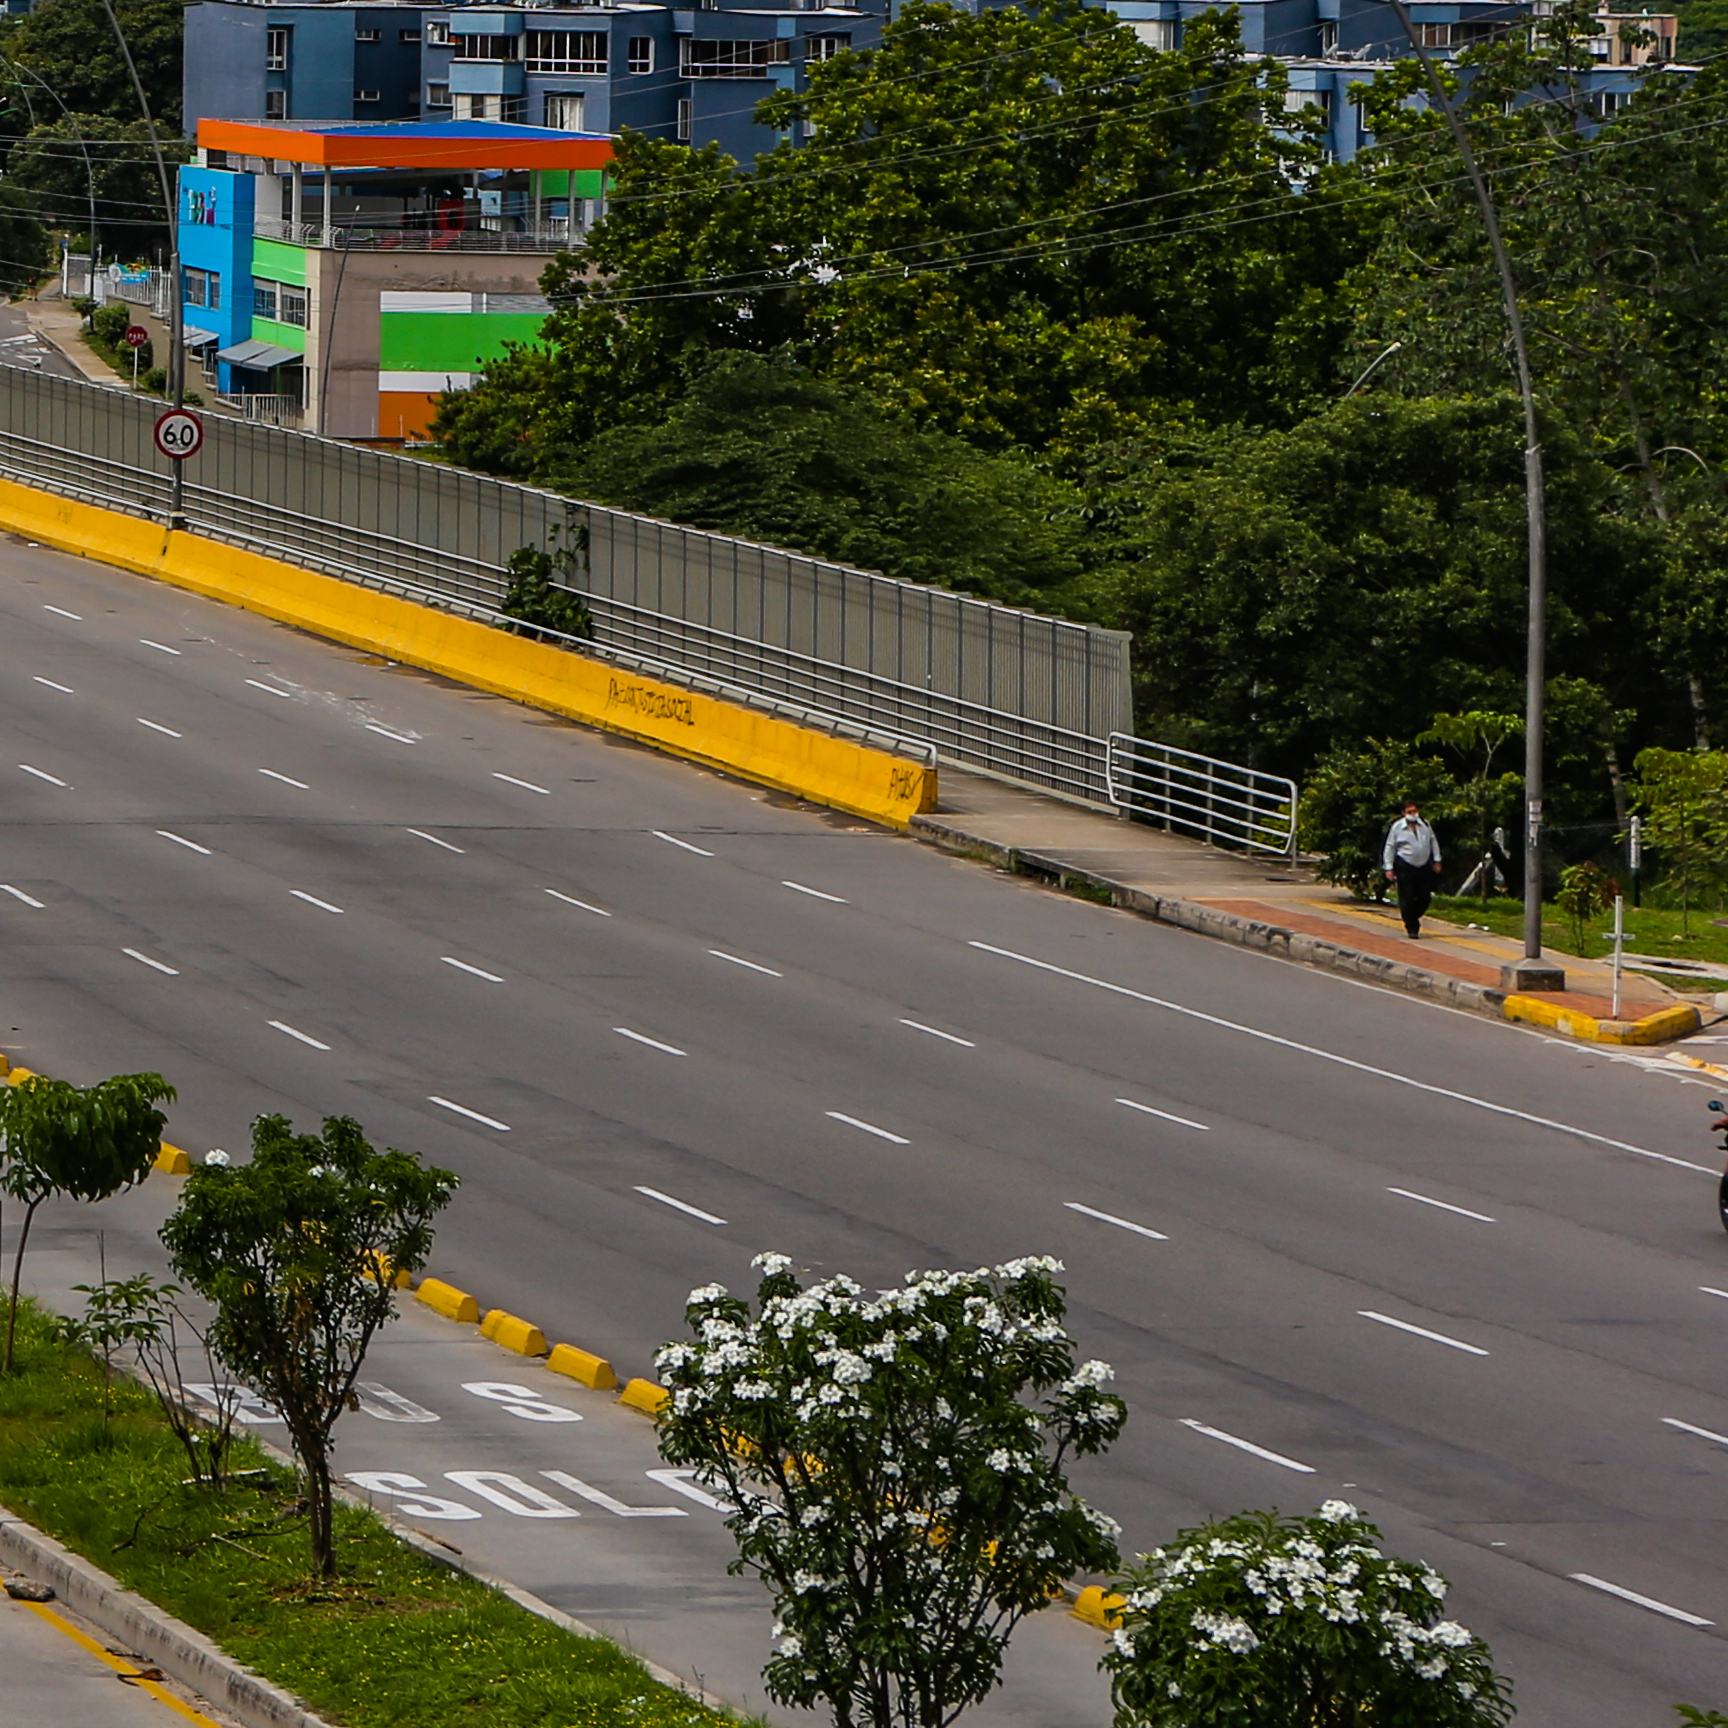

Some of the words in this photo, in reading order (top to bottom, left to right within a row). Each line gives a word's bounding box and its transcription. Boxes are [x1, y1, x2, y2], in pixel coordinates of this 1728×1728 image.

[163, 423, 194, 446] 60
[181, 1380, 584, 1424] BUS
[344, 1469, 784, 1521] SOLO
